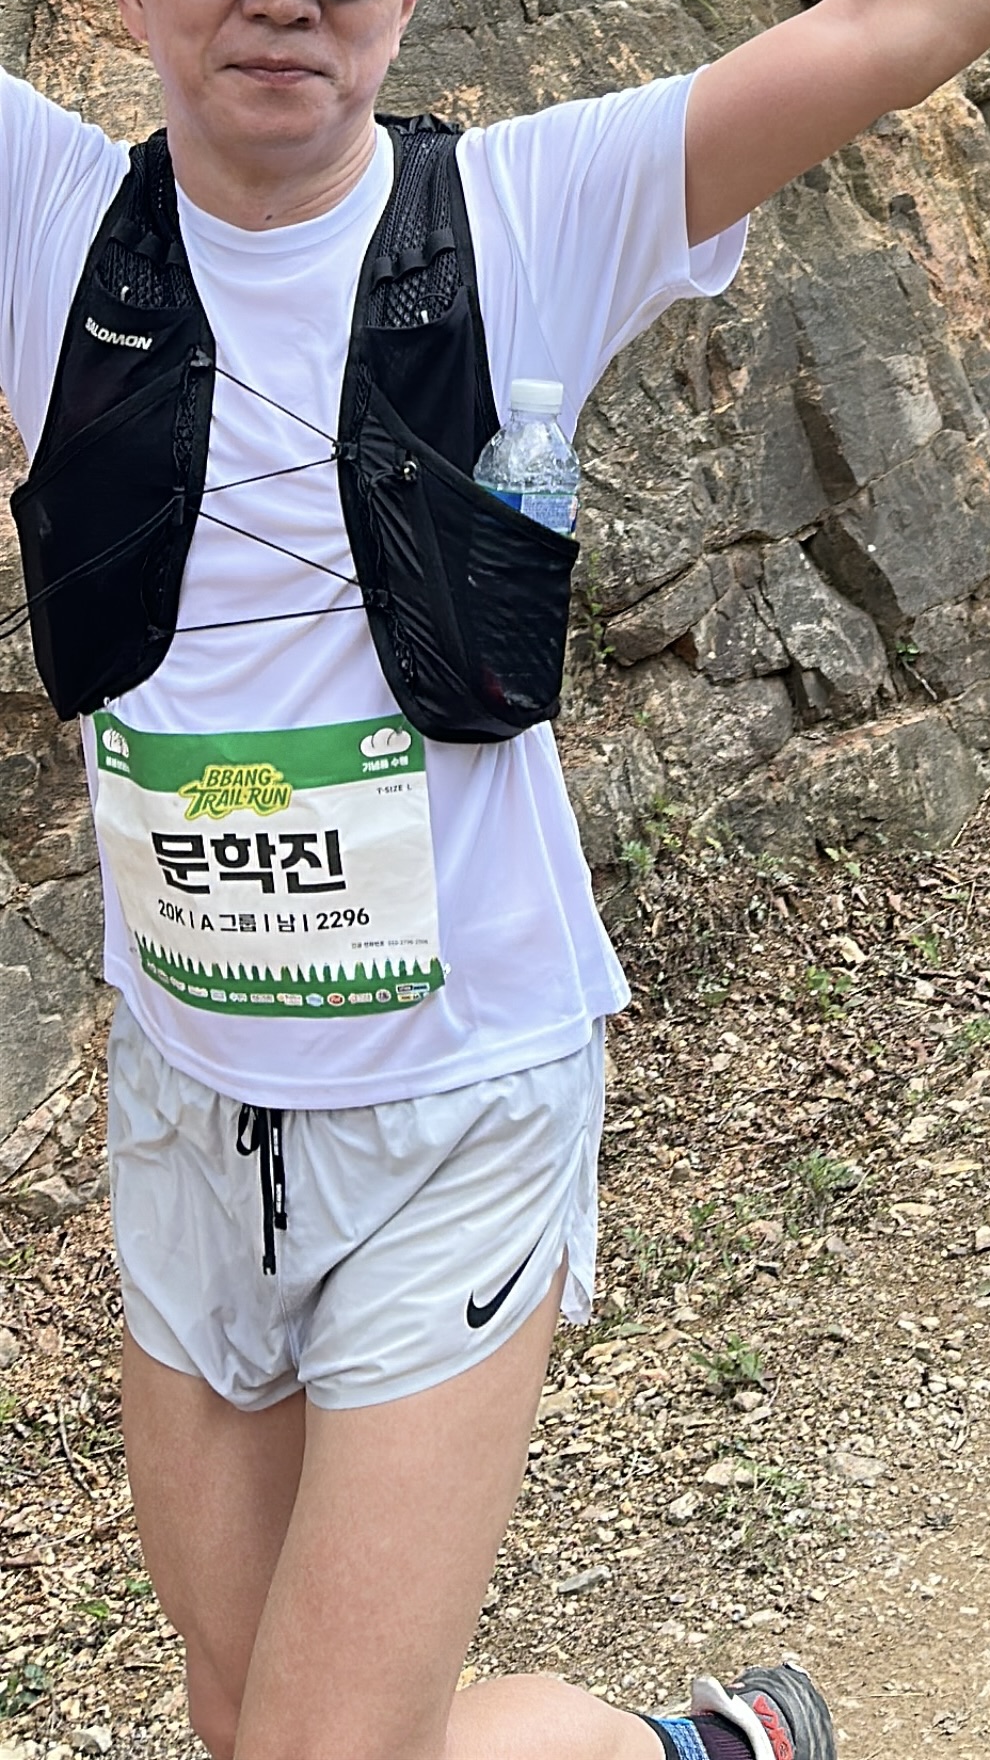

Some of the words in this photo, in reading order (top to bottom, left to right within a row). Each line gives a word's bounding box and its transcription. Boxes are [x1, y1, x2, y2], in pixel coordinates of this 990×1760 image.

[84, 316, 153, 350] SALOMON
[206, 768, 271, 787] BBANG
[151, 829, 346, 895] 문학진
[158, 899, 186, 926] 20K
[276, 914, 295, 932] 남
[316, 907, 370, 931] 2296
